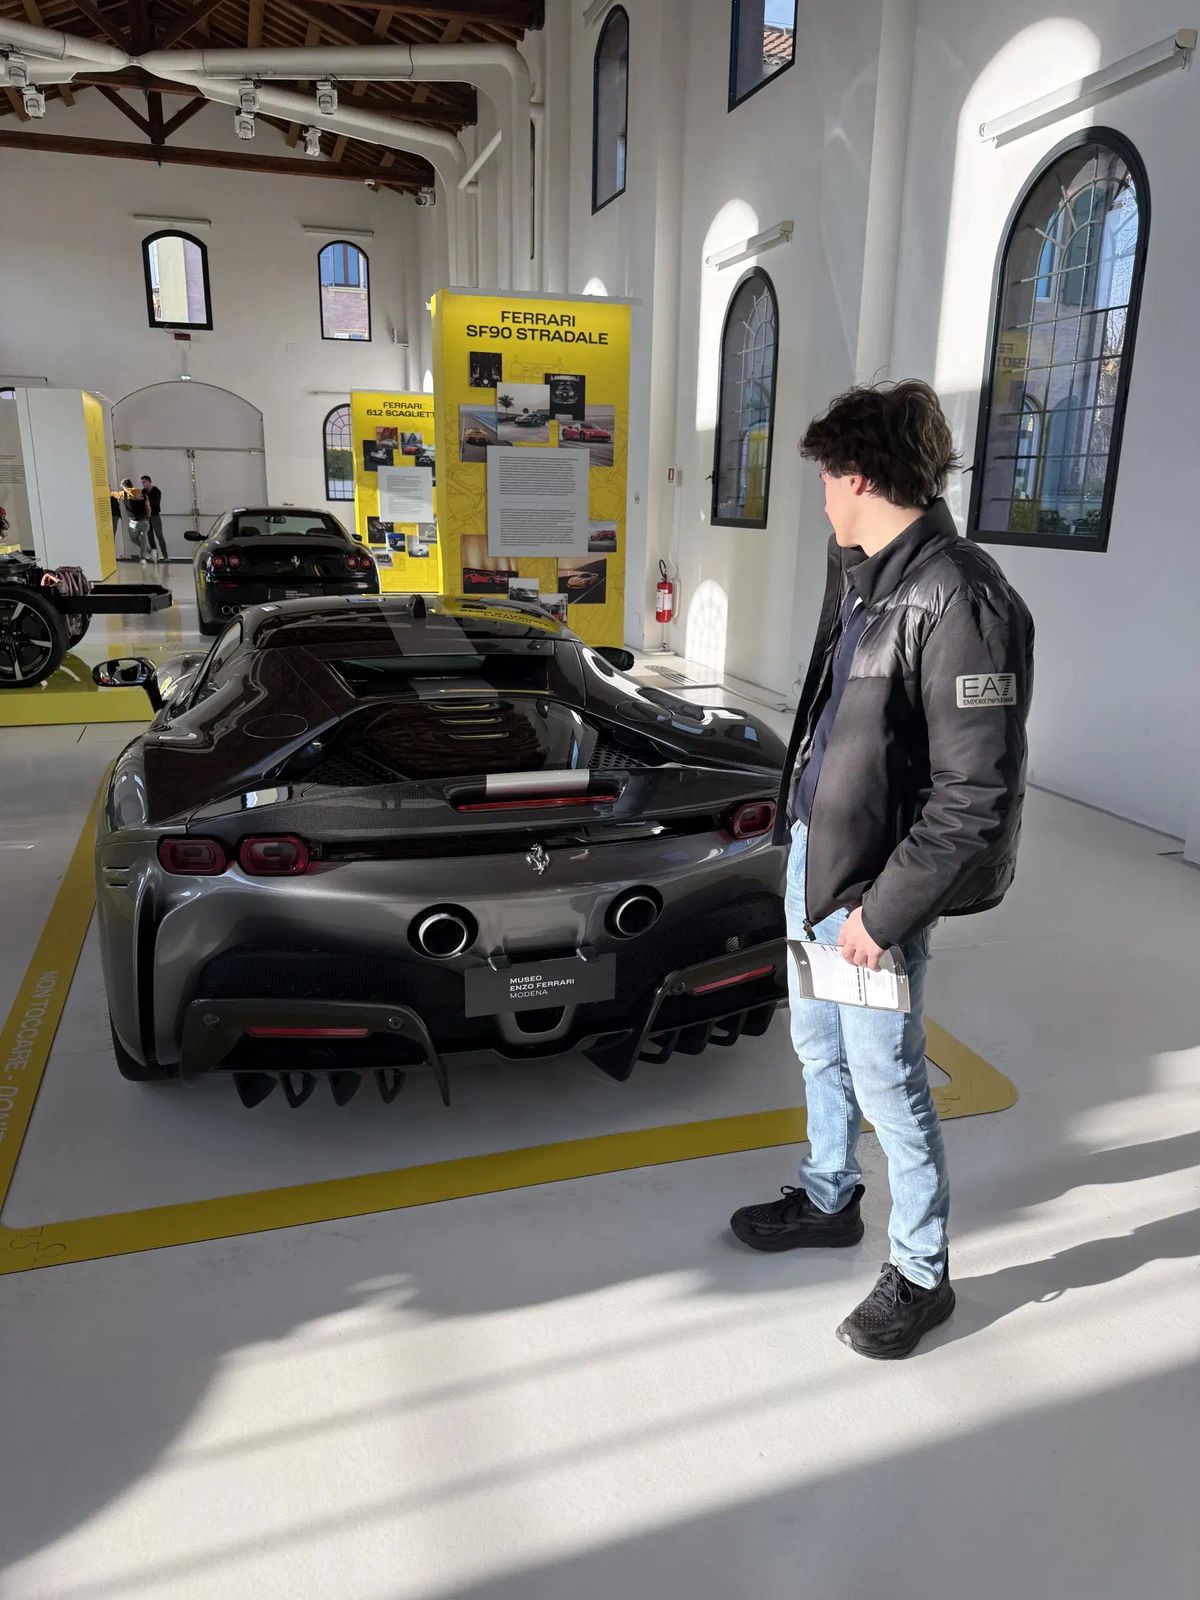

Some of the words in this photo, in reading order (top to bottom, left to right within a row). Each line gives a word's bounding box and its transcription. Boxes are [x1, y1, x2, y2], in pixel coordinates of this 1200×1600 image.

[501, 310, 576, 327] FERRARI
[466, 324, 512, 339] SF90
[516, 327, 609, 345] STRADALE
[963, 676, 1012, 698] EA7
[32, 970, 59, 998] NON
[510, 975, 542, 984] MUSEO
[510, 983, 534, 991] ENZO
[536, 978, 575, 988] FERRARI
[510, 989, 548, 998] MODENA
[4, 1000, 48, 1072] TOCCARE
